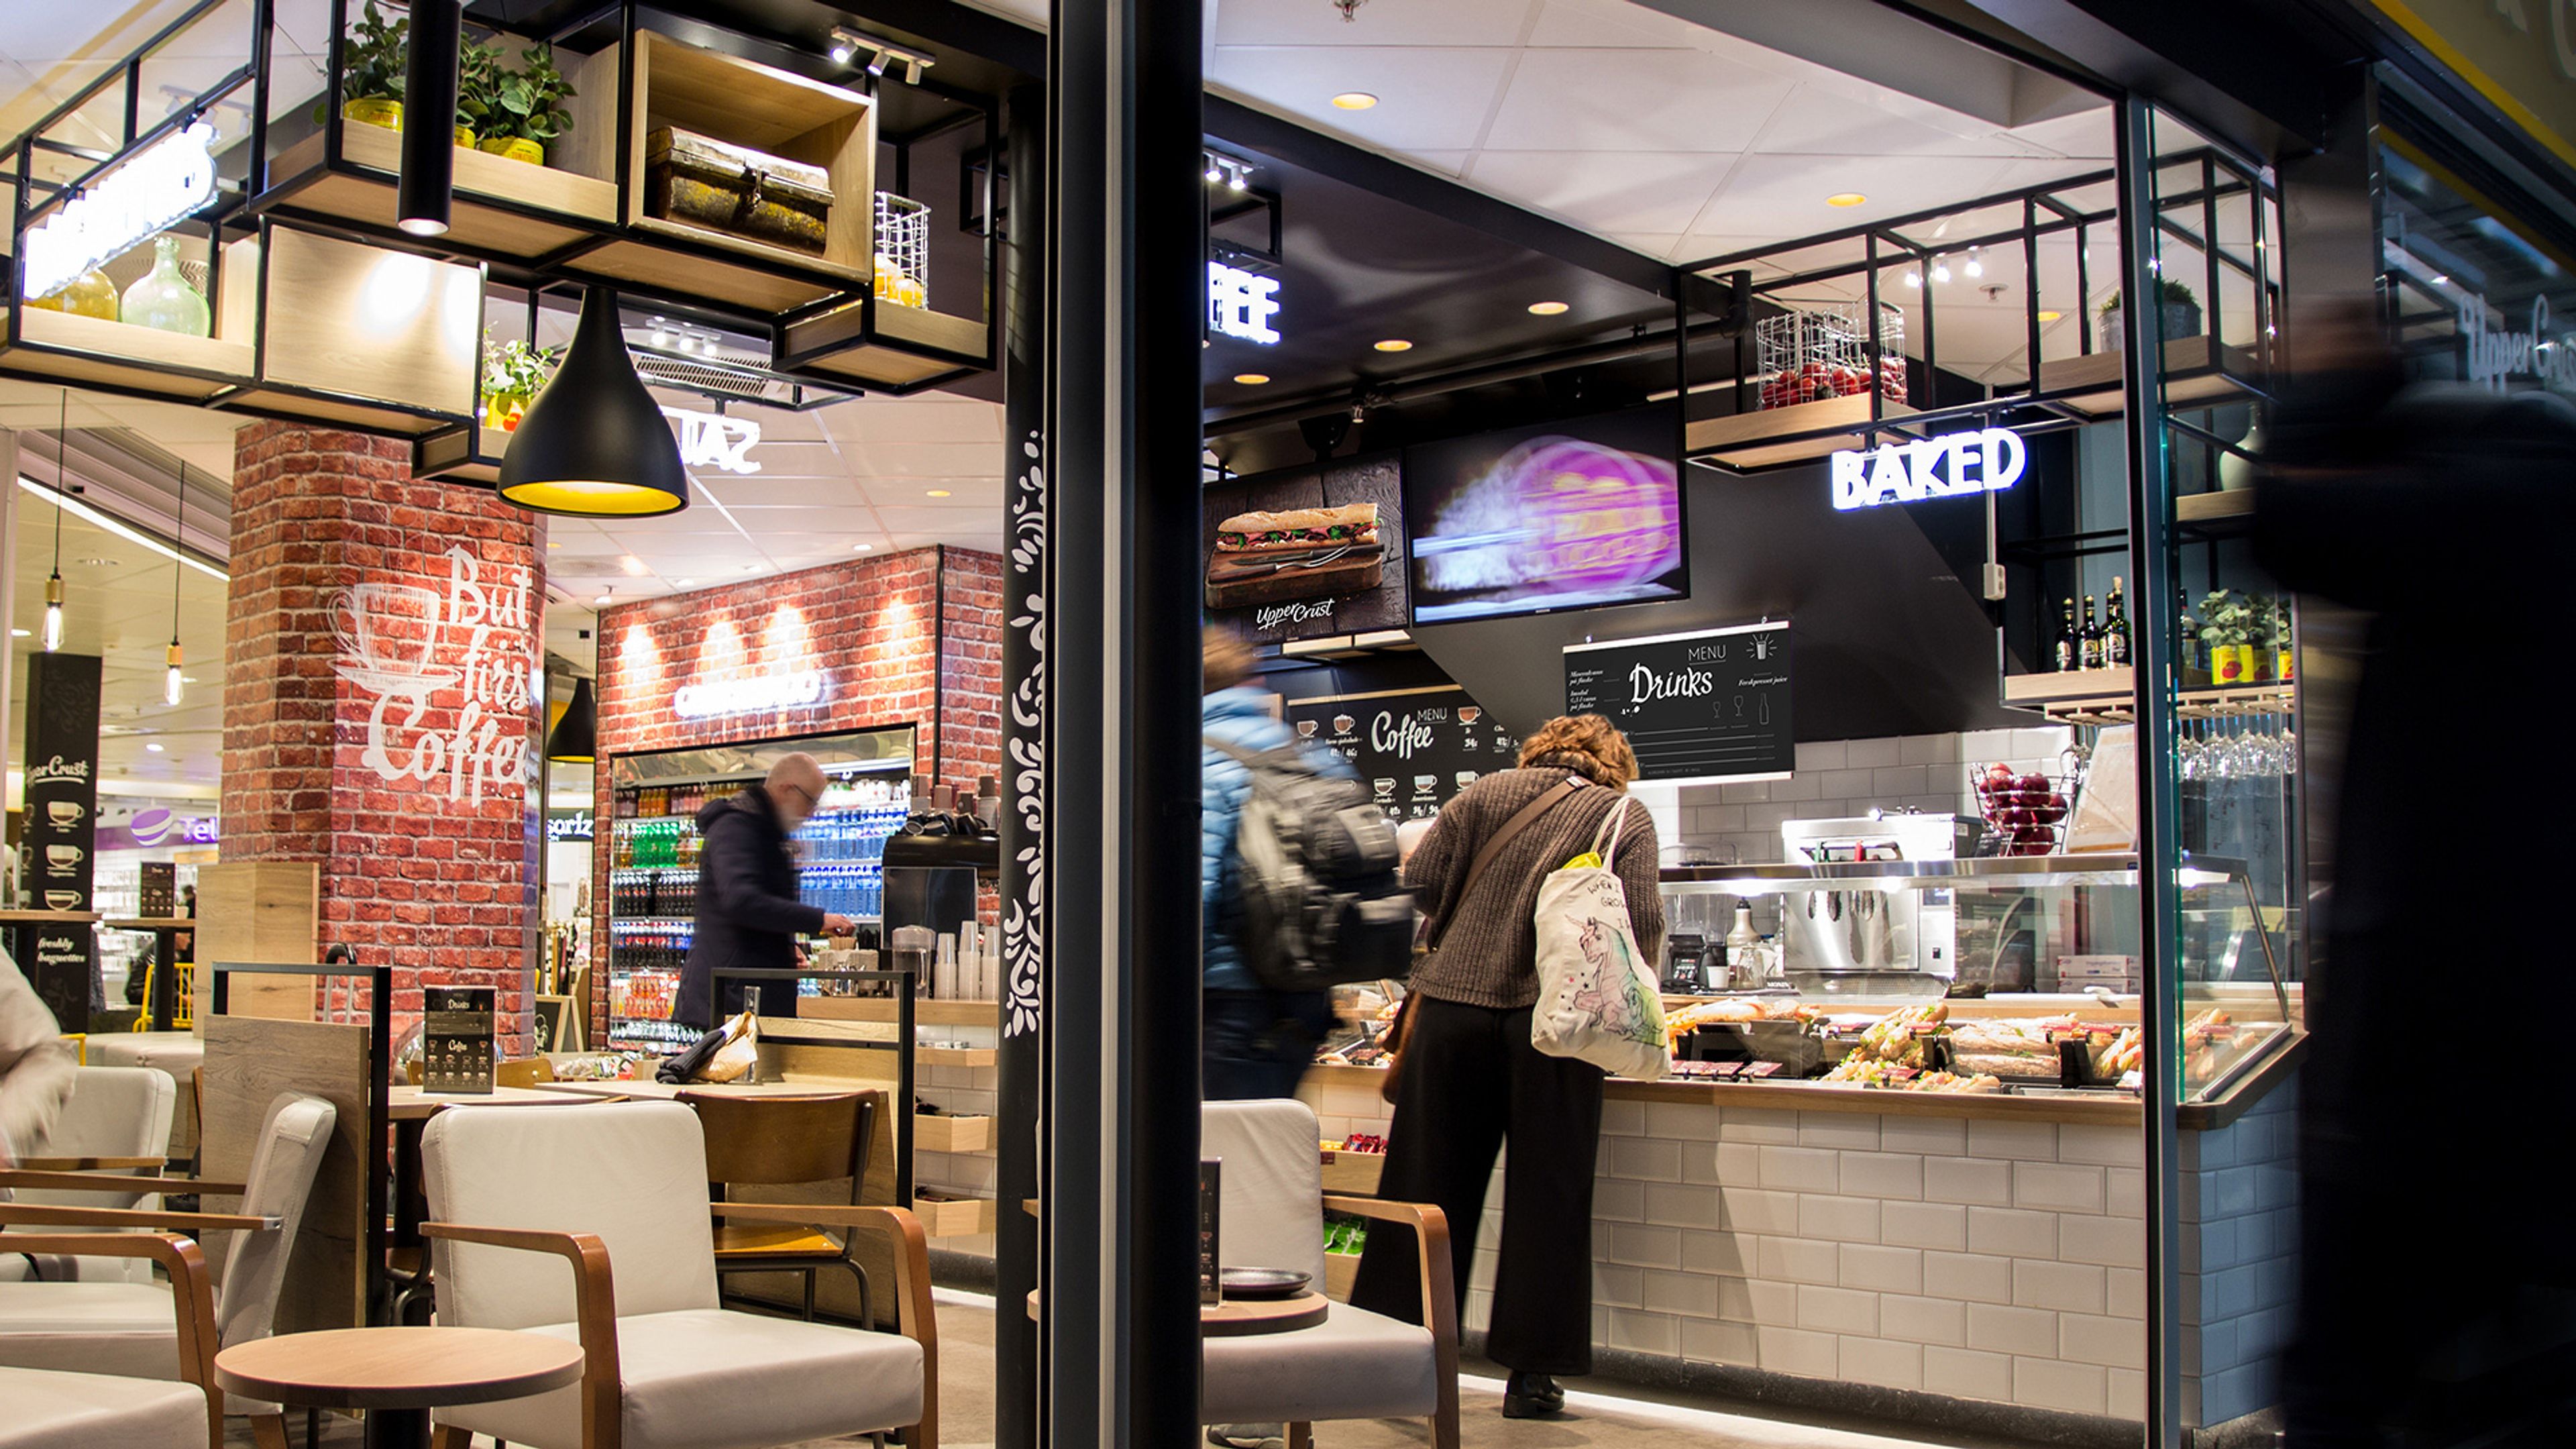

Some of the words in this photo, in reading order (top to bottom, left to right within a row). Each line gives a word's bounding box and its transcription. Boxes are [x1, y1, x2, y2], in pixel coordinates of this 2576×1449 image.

[2459, 293, 2532, 392] Upper
[2532, 292, 2576, 384] Crus
[1831, 428, 2027, 511] BAKED
[445, 544, 533, 629] But
[1256, 602, 1300, 630] Upper
[1293, 598, 1336, 623] Crust
[461, 624, 534, 711] firs
[1688, 644, 1726, 661] MENU
[1629, 662, 1713, 703] Drinks
[1417, 707, 1448, 721] MENU
[1371, 710, 1434, 759] Coffee
[48, 755, 89, 777] Crust
[178, 816, 218, 843] Tel
[38, 951, 86, 966] baguettes
